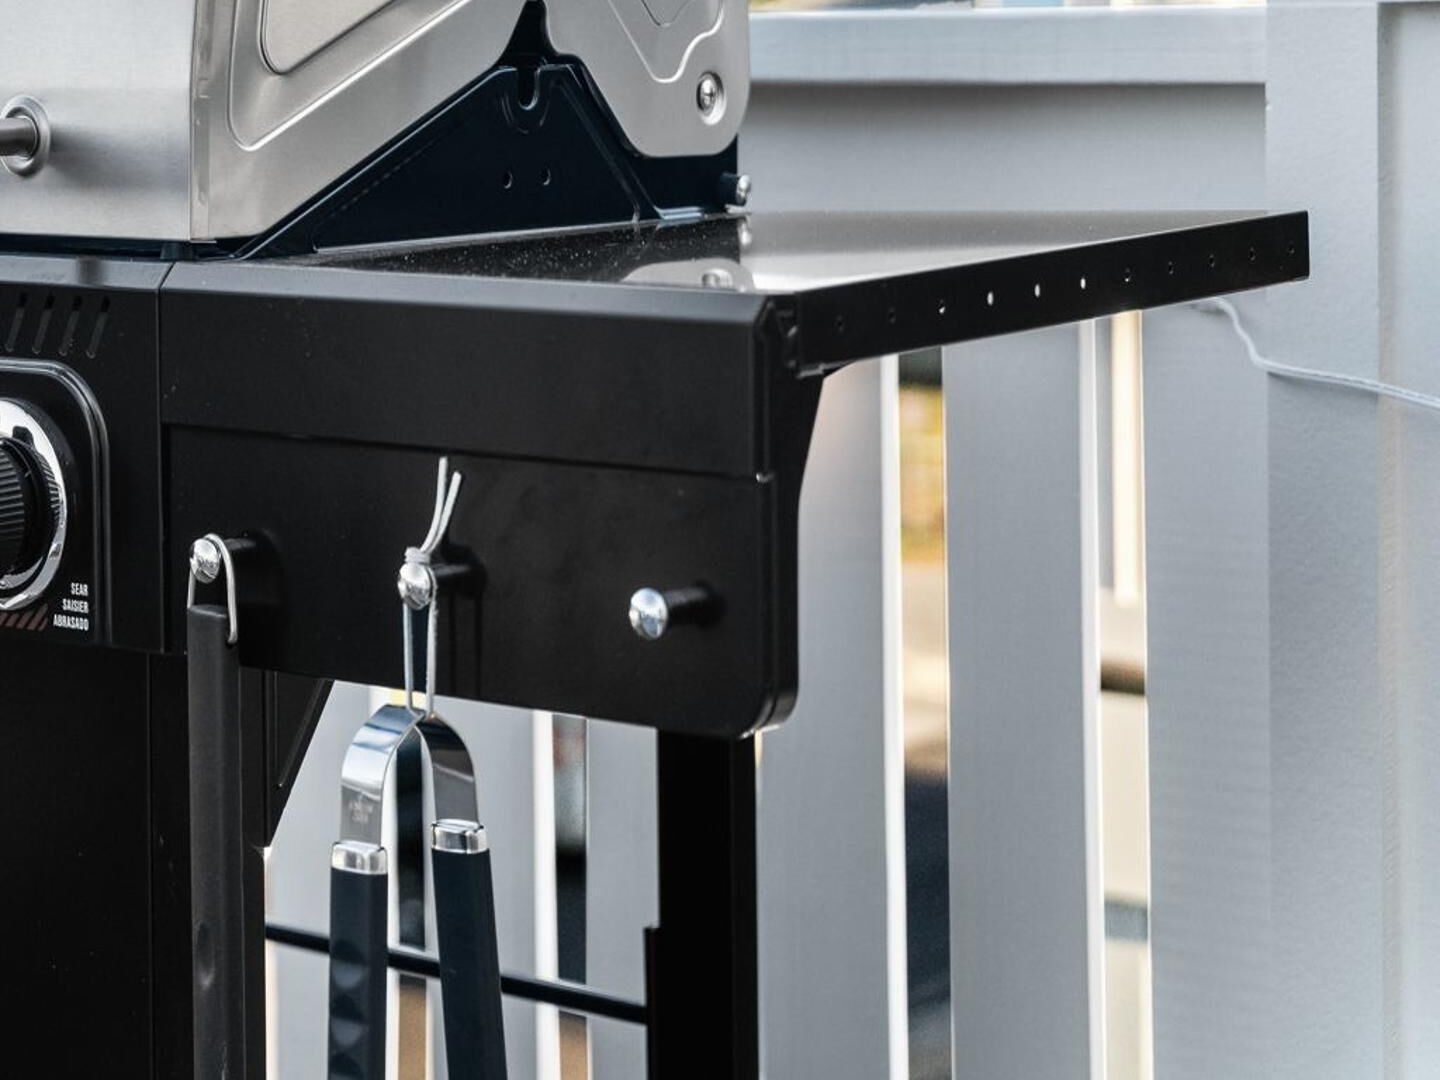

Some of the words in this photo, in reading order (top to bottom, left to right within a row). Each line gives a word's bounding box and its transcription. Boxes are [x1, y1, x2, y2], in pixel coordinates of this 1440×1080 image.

[71, 582, 88, 596] SEAR
[62, 598, 89, 613] SAISIER
[53, 614, 89, 631] ABRASADO
